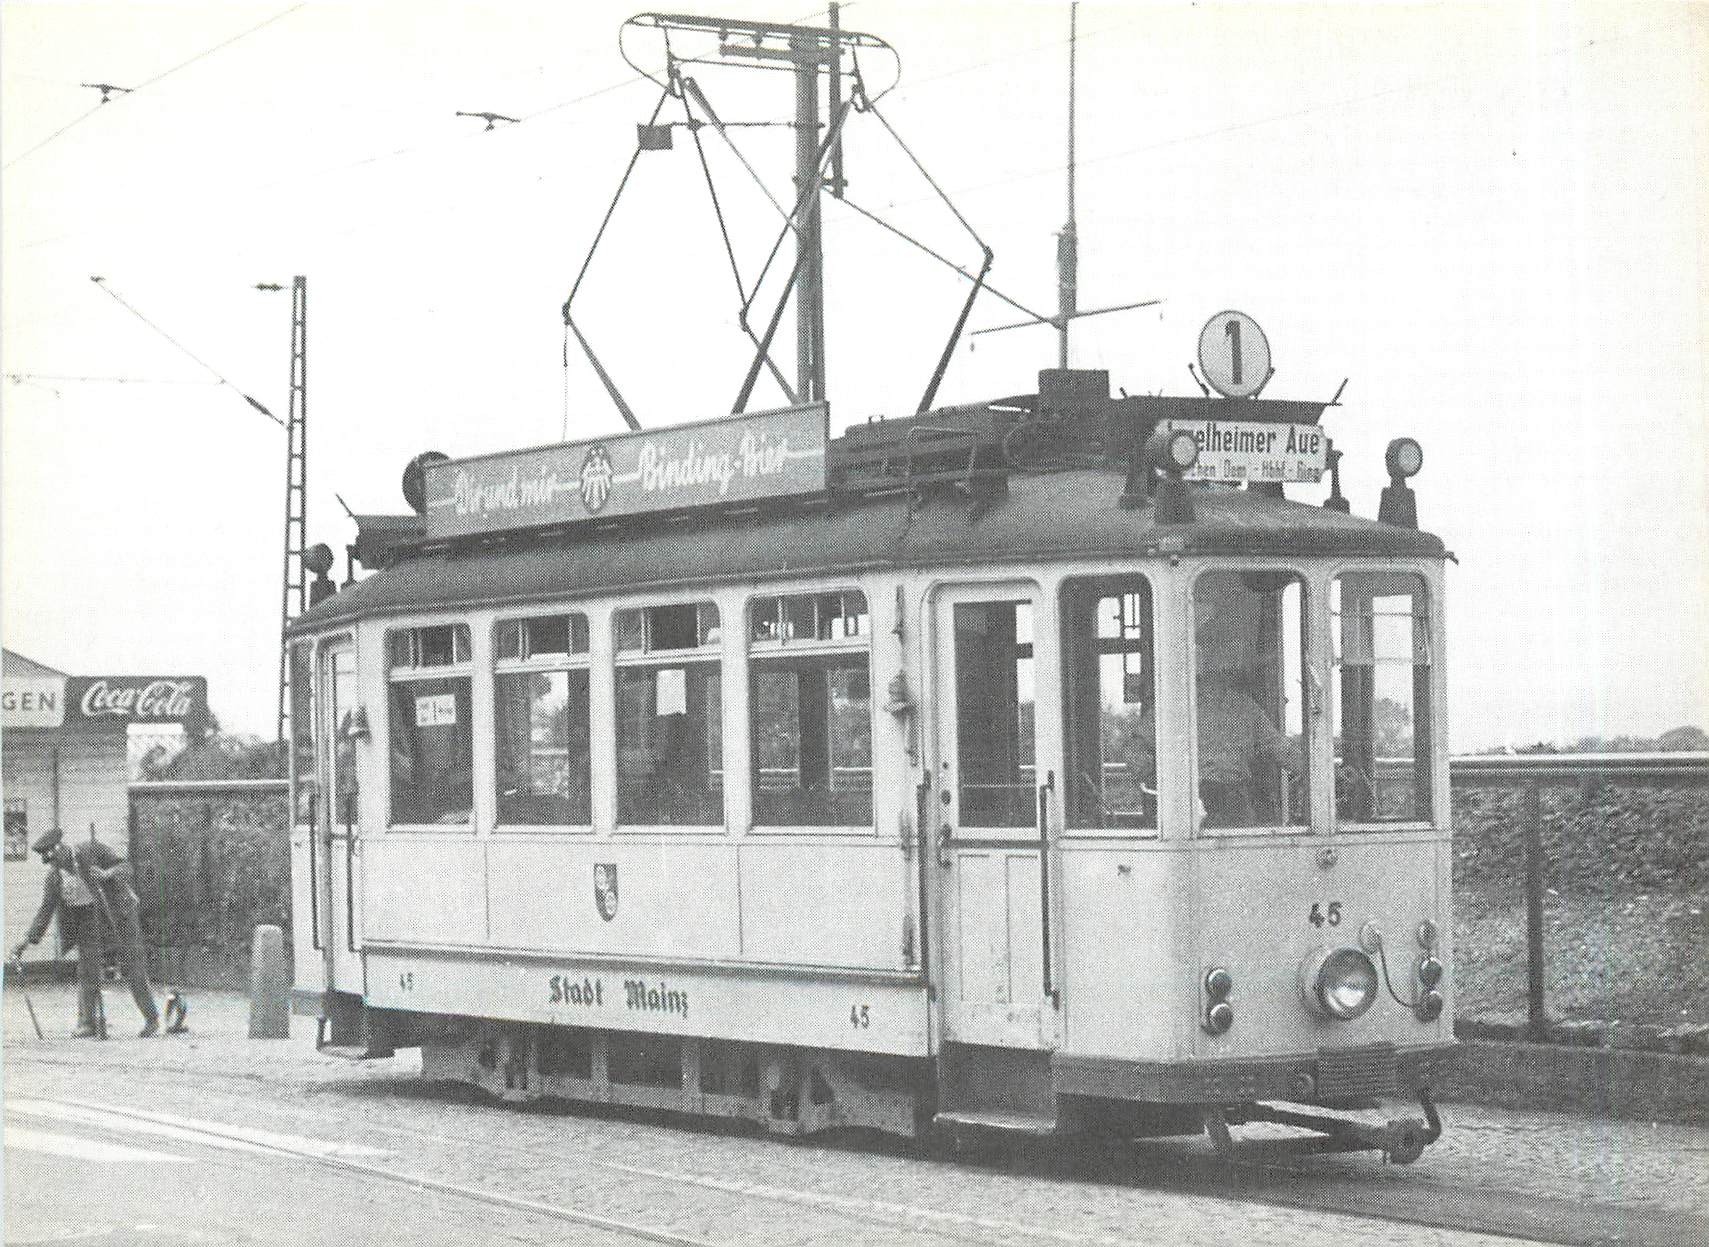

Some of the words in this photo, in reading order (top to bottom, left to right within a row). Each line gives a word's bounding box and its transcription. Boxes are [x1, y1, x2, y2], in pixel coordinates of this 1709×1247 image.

[1224, 320, 1243, 385] 1
[1167, 421, 1277, 453] elheimer
[1286, 425, 1320, 454] Aue
[2, 690, 56, 711] GEN
[1309, 901, 1343, 928] 45
[548, 974, 604, 1007] Stadt
[624, 978, 690, 1019] Mainz
[848, 1003, 871, 1030] 45
